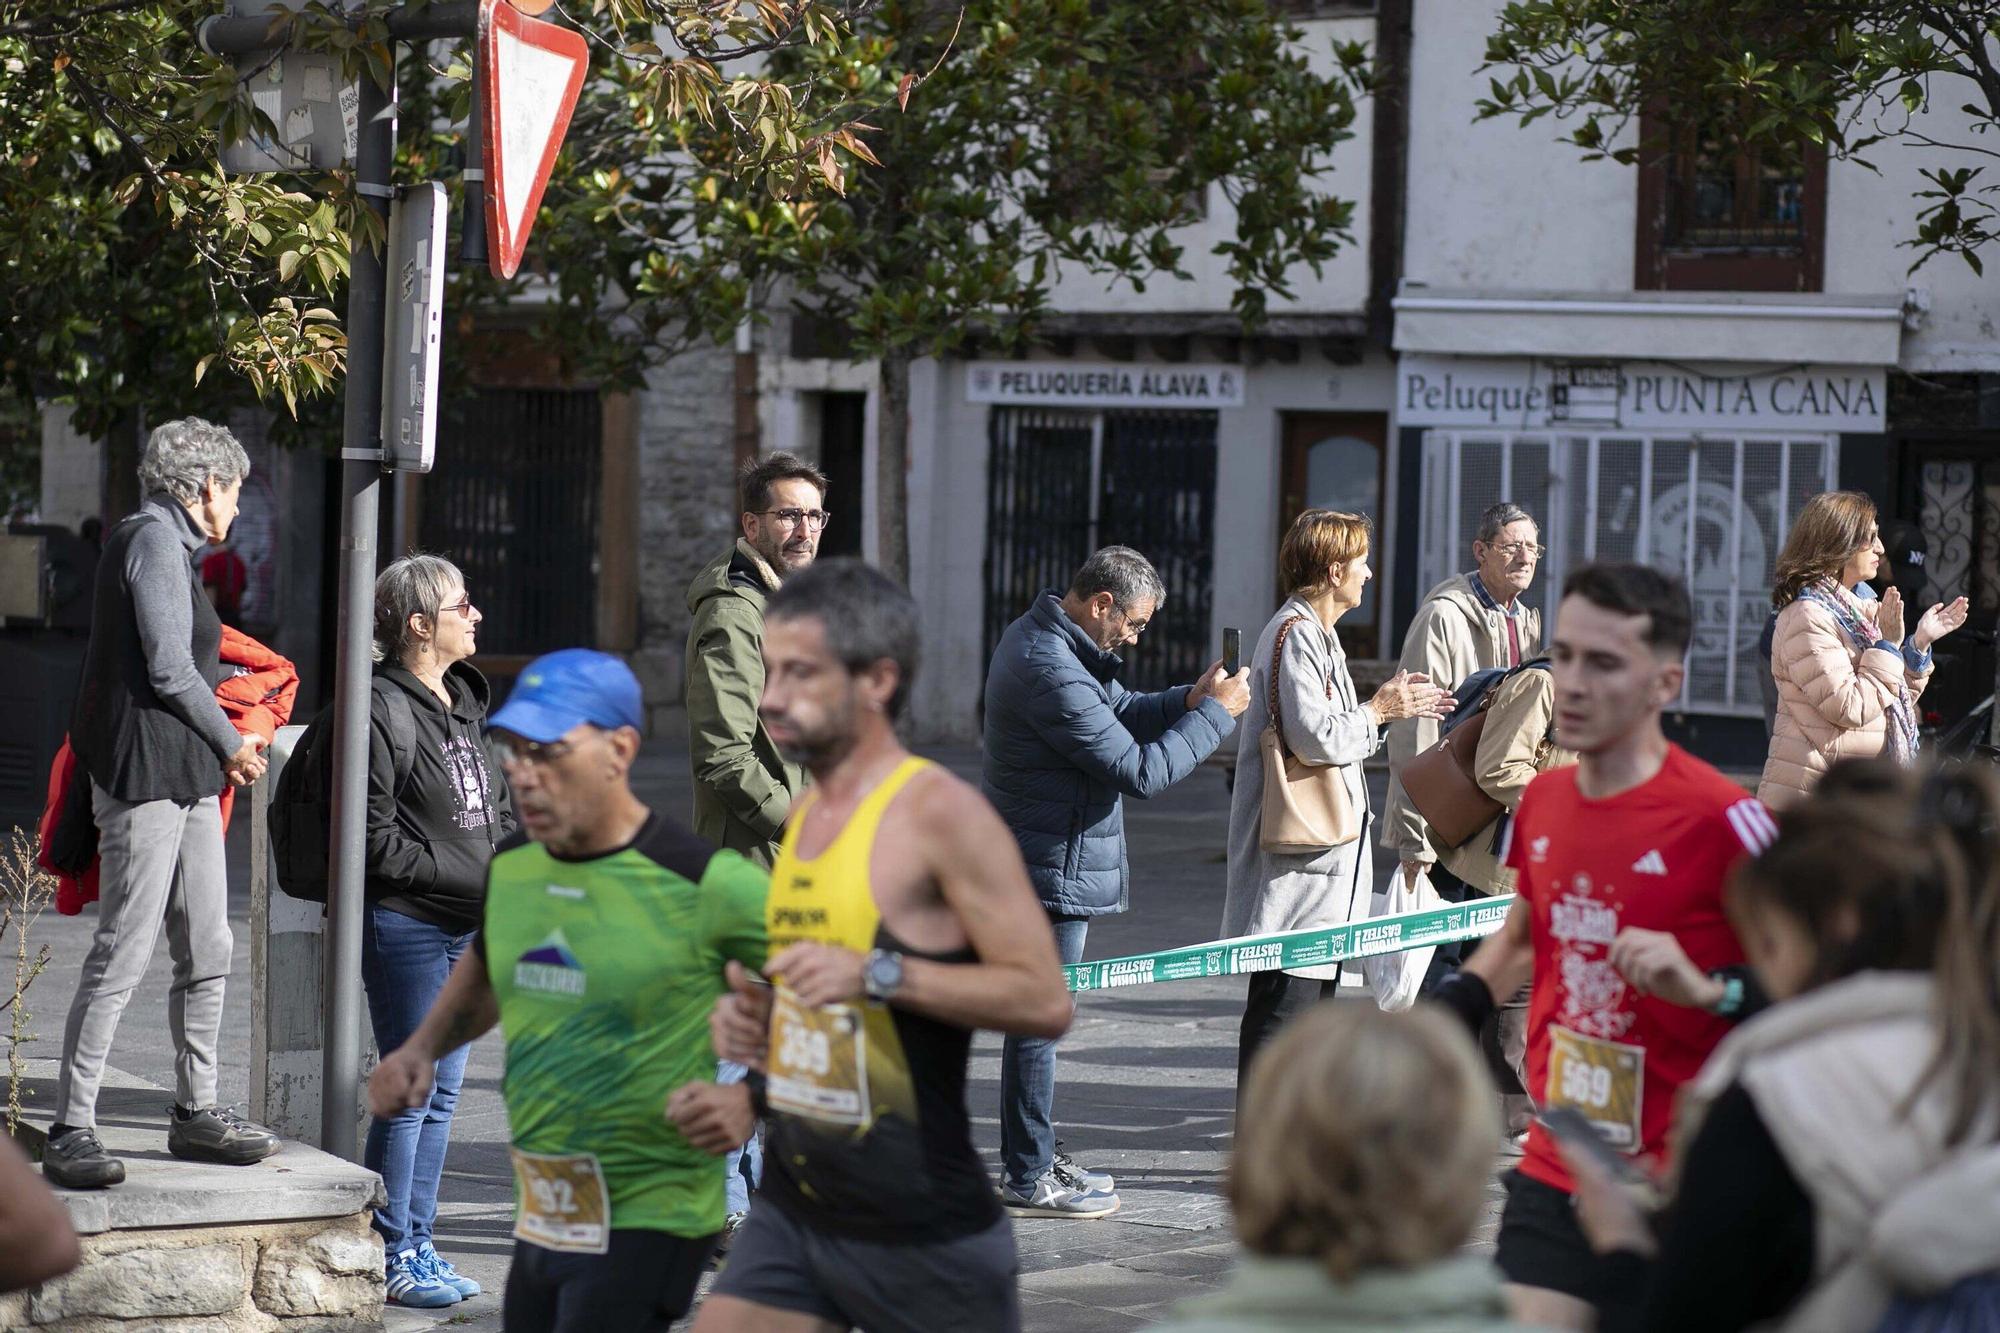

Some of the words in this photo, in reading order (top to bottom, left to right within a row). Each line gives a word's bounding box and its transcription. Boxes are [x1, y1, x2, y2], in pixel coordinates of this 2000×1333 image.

[1001, 369, 1132, 395] PELUQUERÍA
[1140, 367, 1209, 396] ÁLAVA
[1406, 373, 1552, 422] Peluque
[1633, 375, 1757, 413] PUNTA
[1770, 376, 1878, 415] CANA
[1477, 905, 1510, 922] ASTEIZ
[1363, 924, 1402, 942] GASTEIZ
[1239, 943, 1283, 959] GASTEIZ
[1110, 959, 1155, 976] GASTEIZ
[1238, 956, 1282, 973] VITORIA
